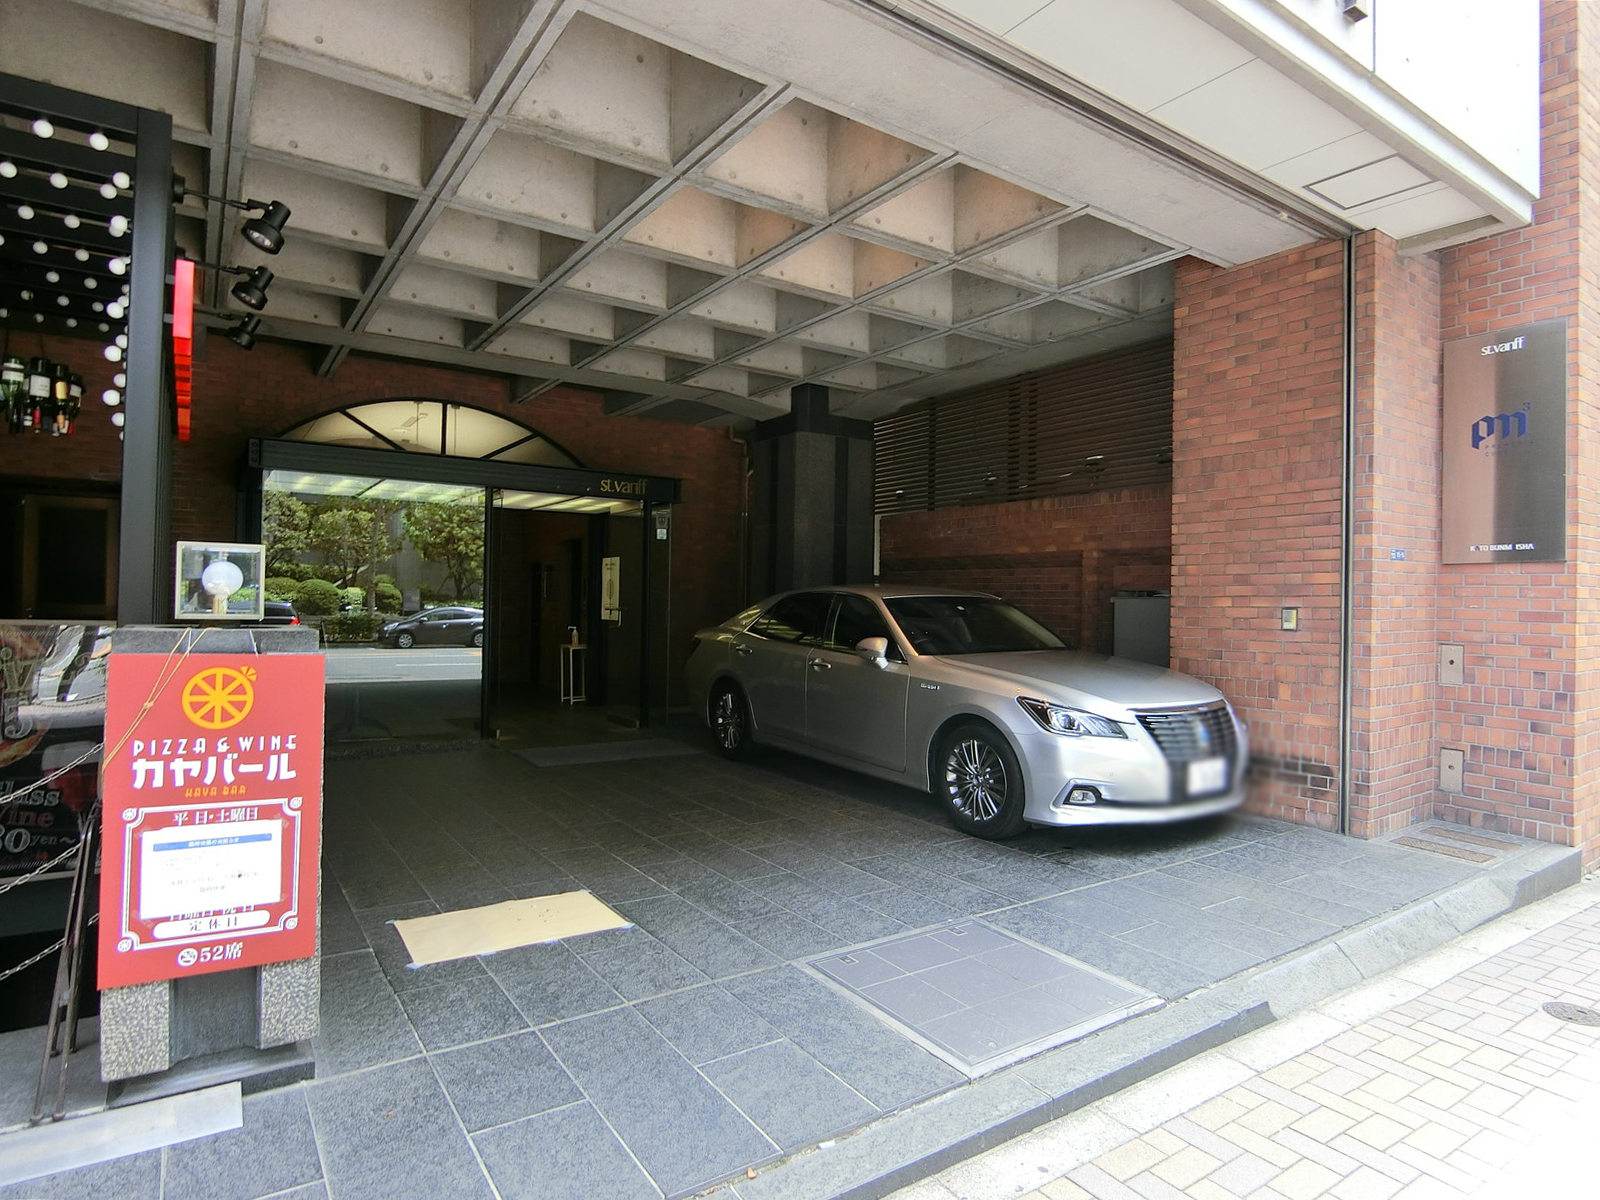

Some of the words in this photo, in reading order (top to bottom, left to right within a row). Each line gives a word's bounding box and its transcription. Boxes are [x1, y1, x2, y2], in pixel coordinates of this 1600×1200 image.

[132, 738, 207, 757] PIZZA
[217, 737, 230, 753] &
[238, 734, 297, 752] WINE
[131, 753, 297, 789] カヤバール
[222, 784, 247, 796] BAR
